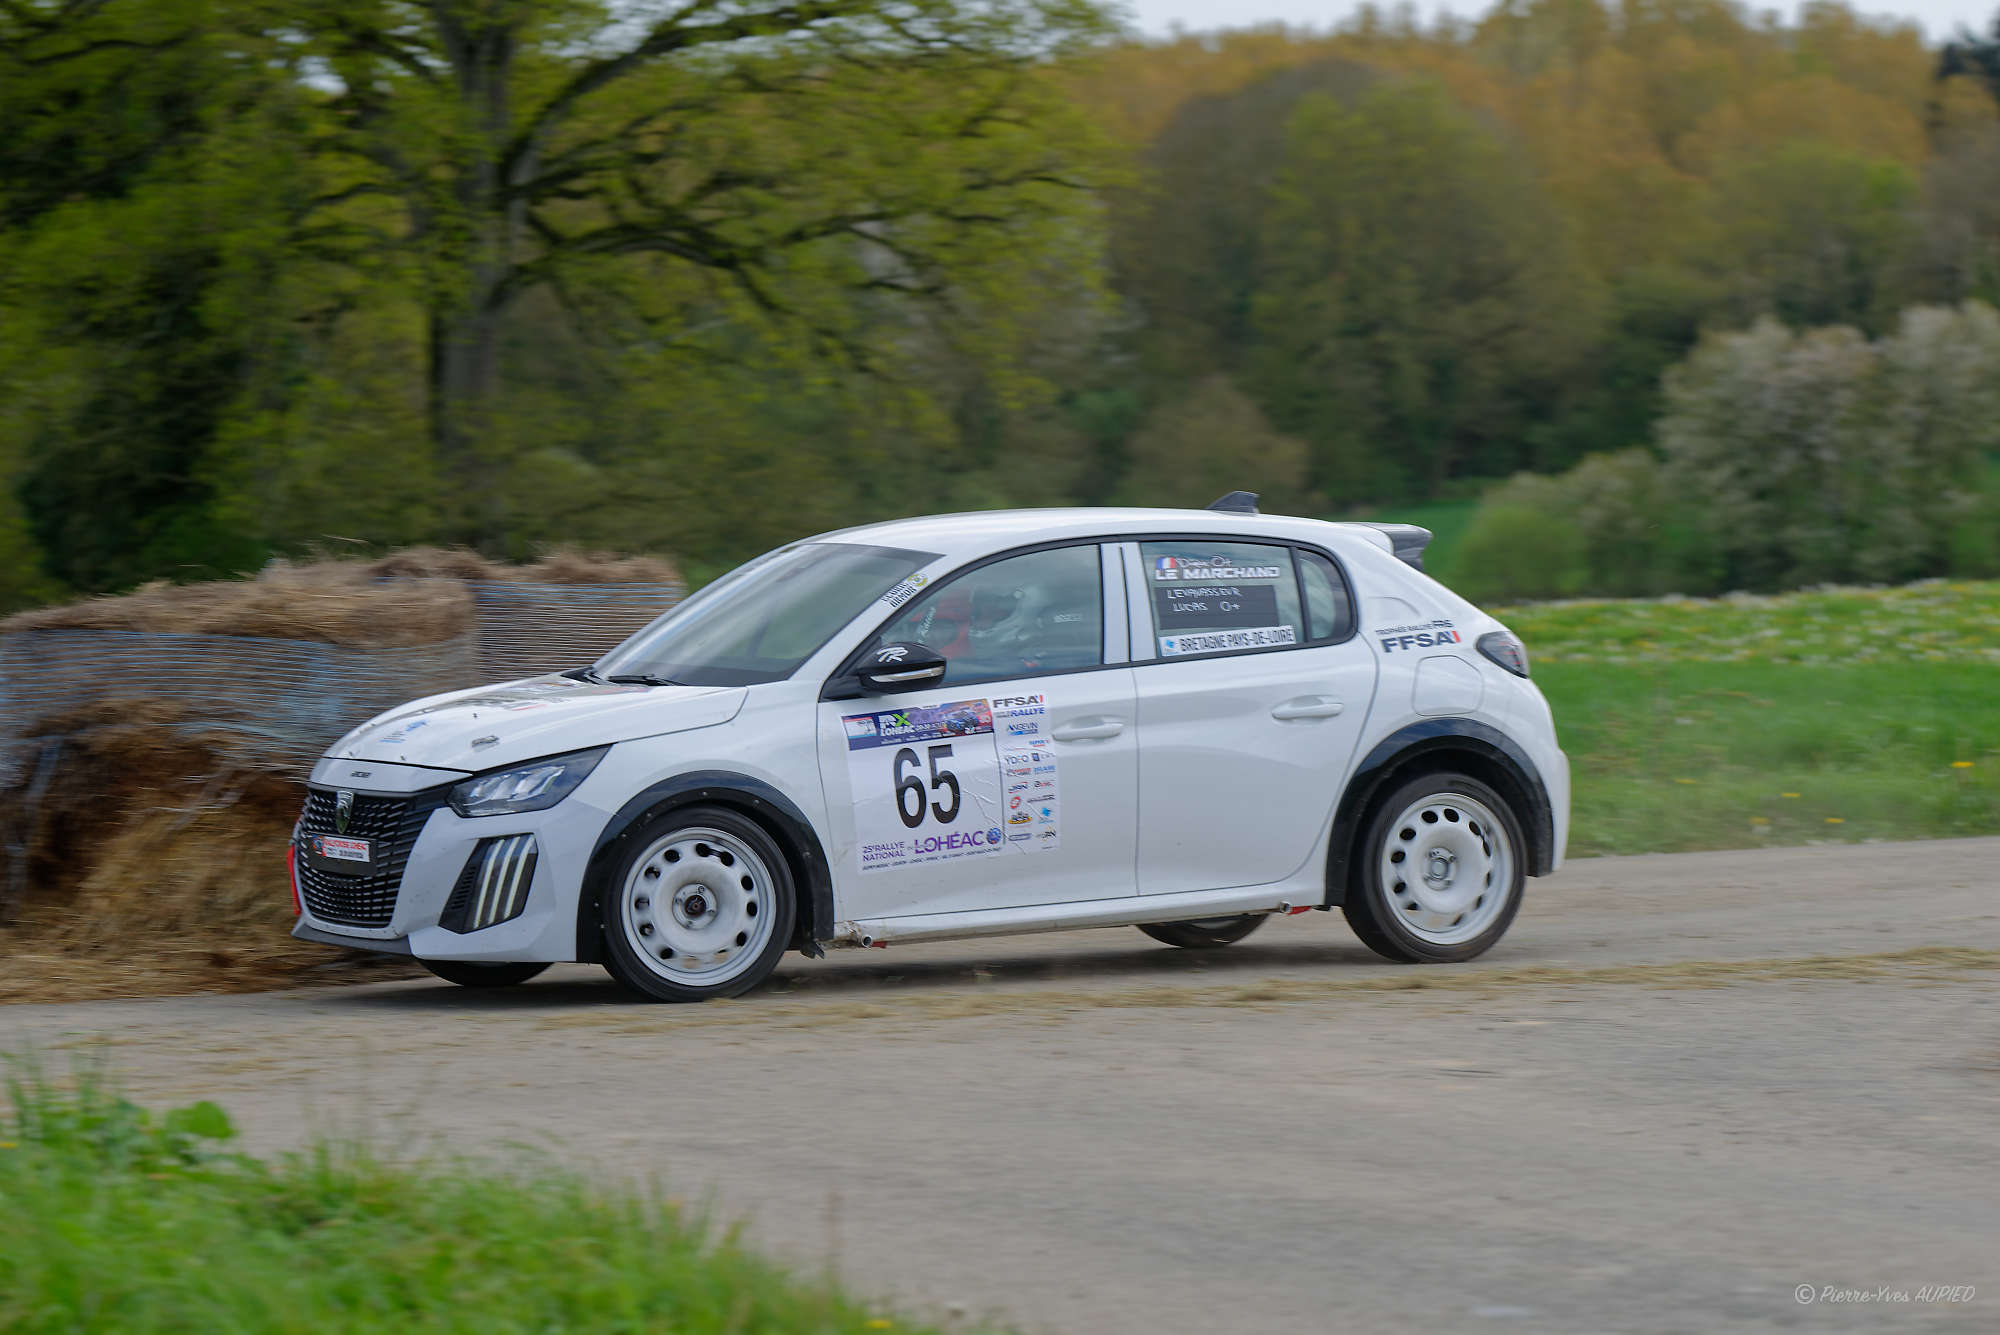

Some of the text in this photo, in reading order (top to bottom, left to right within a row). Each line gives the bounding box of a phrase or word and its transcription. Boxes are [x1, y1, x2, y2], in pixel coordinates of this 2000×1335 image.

[1155, 566, 1281, 581] LE MARCHAND
[1172, 600, 1241, 612] LUCAS O+
[1180, 628, 1295, 652] BRETAGNE PAYS-DE-LOIRE
[1379, 631, 1457, 653] FFSA
[992, 695, 1039, 708] FFSA
[1010, 707, 1045, 717] RALLYE
[893, 743, 961, 829] 65
[873, 842, 905, 852] RALLYE
[915, 831, 985, 854] LOHÉAC
[862, 850, 906, 862] NATIONAL
